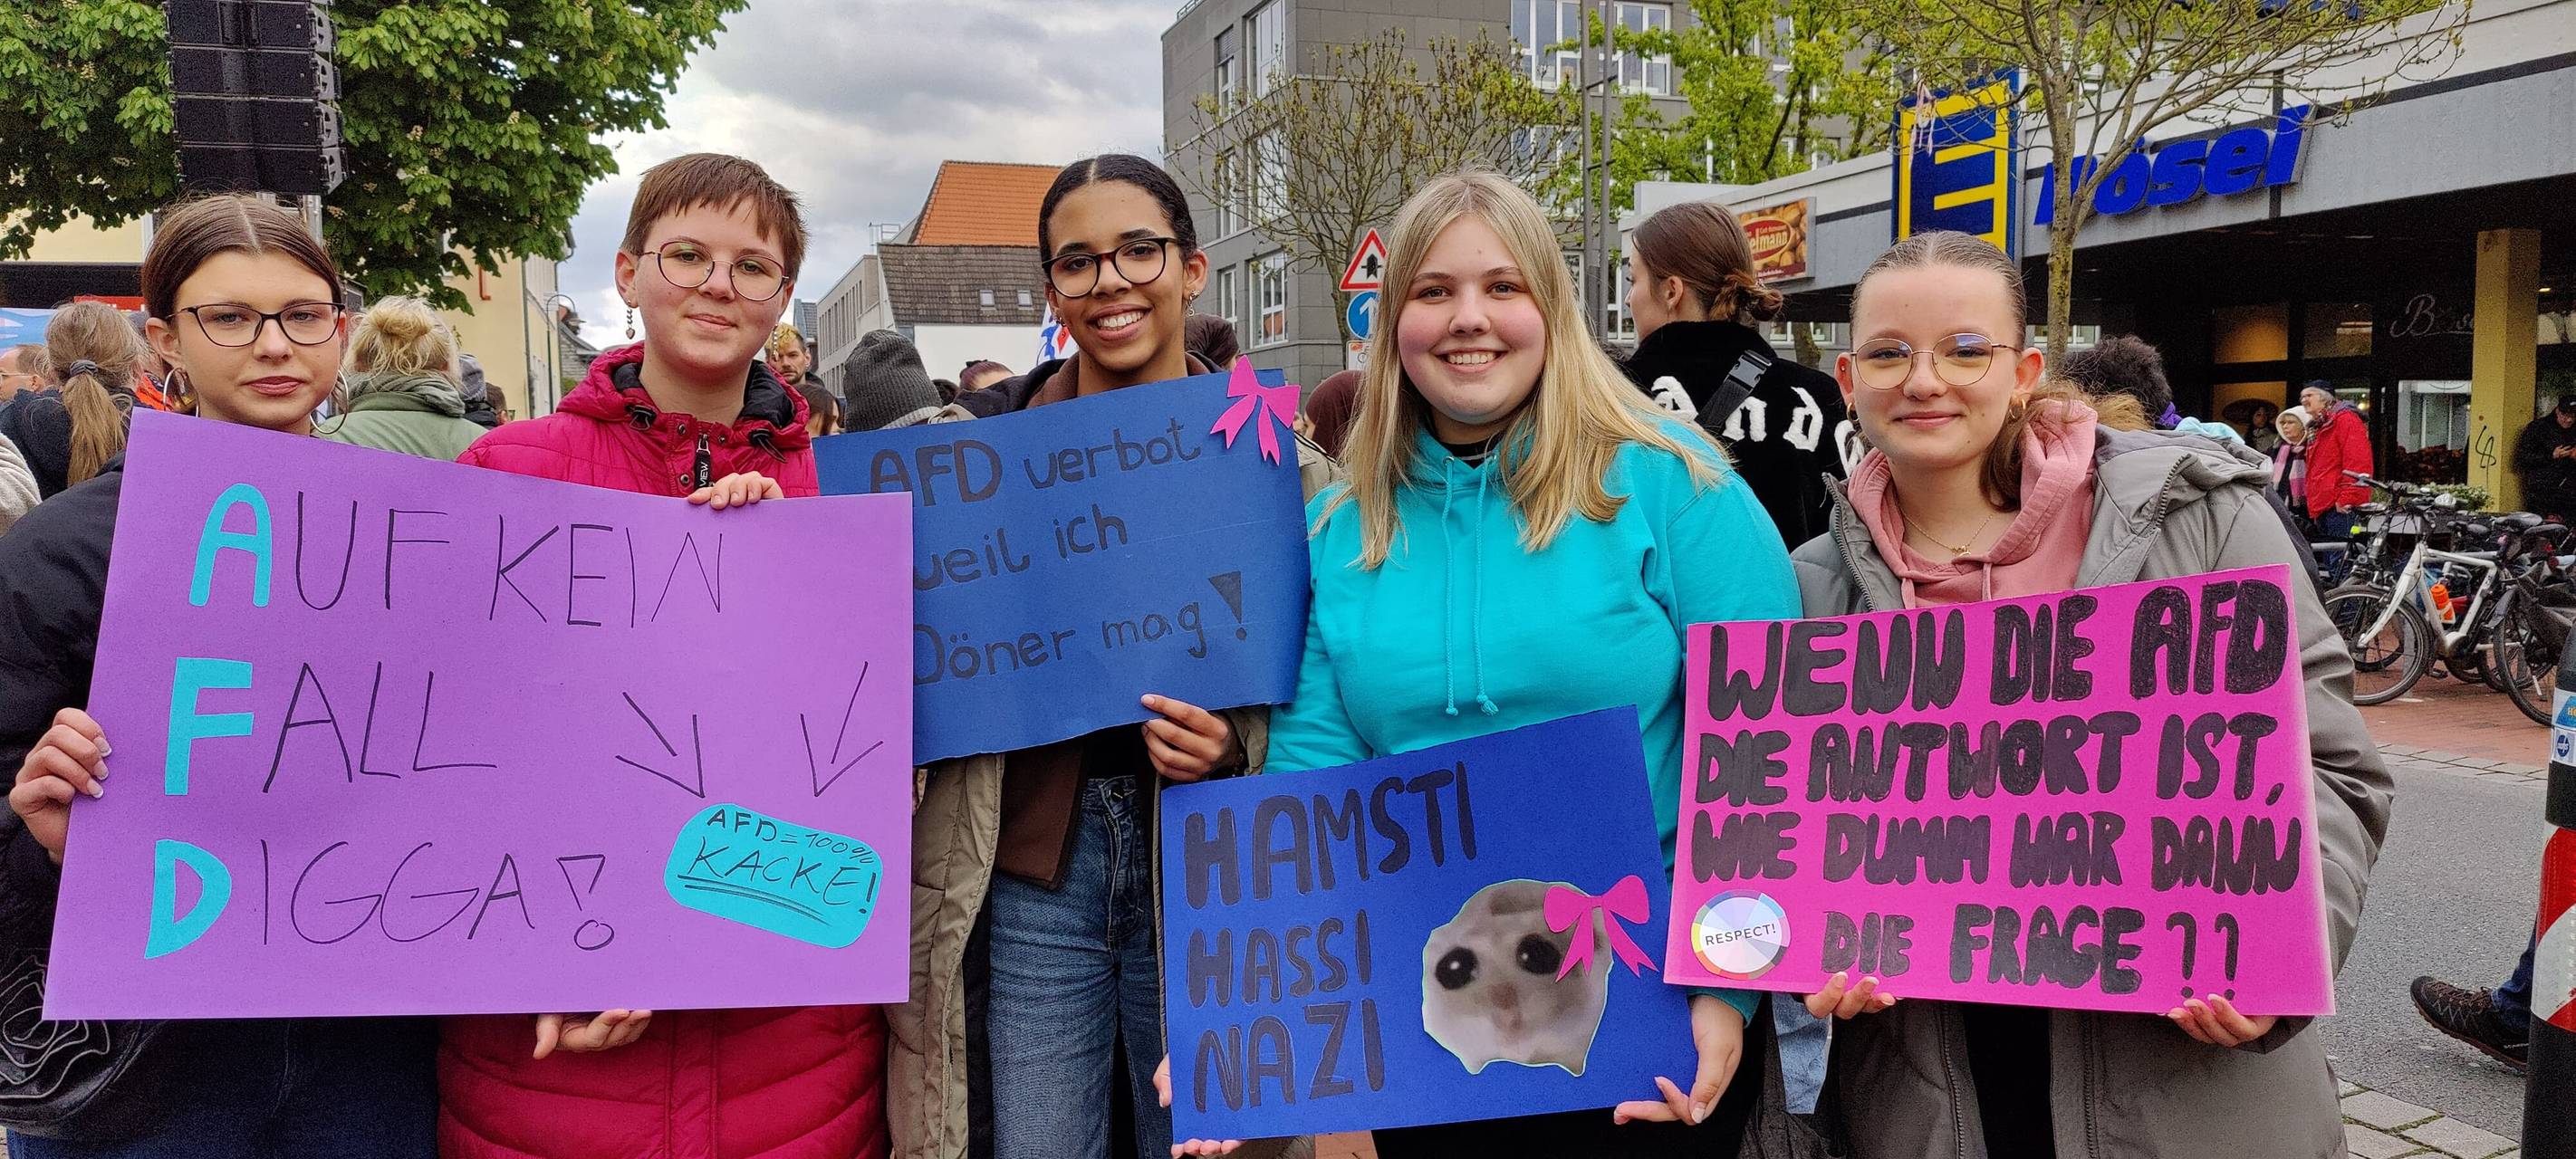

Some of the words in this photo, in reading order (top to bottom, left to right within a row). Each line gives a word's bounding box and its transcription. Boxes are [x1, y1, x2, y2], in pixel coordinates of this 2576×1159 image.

[870, 440, 1003, 507] AFD
[1024, 417, 1201, 489] verbot
[188, 483, 450, 610] AUF
[490, 514, 722, 627] KEIN
[1053, 504, 1128, 560] ich
[913, 624, 1075, 685] Döner
[1707, 609, 1966, 721] WENN
[1990, 595, 2097, 705] DIE
[2129, 580, 2288, 699] AFD
[165, 656, 496, 795] FALL
[1695, 730, 1791, 807] DIE
[1806, 711, 2141, 802] ANTWORT
[2156, 712, 2284, 805] IST,
[688, 837, 876, 914] KACKE!
[1184, 761, 1476, 909] HAMSTI
[1691, 810, 1801, 884] WIE
[1823, 813, 1990, 884] DUMM
[2010, 811, 2126, 887] WAR
[2150, 815, 2302, 896] DANN
[144, 838, 614, 959] DIGGA!
[1706, 924, 1775, 945] RESPECT!
[1821, 911, 1914, 977] DIE
[1187, 909, 1371, 1008] HASSI
[1194, 998, 1385, 1113] NAZI
